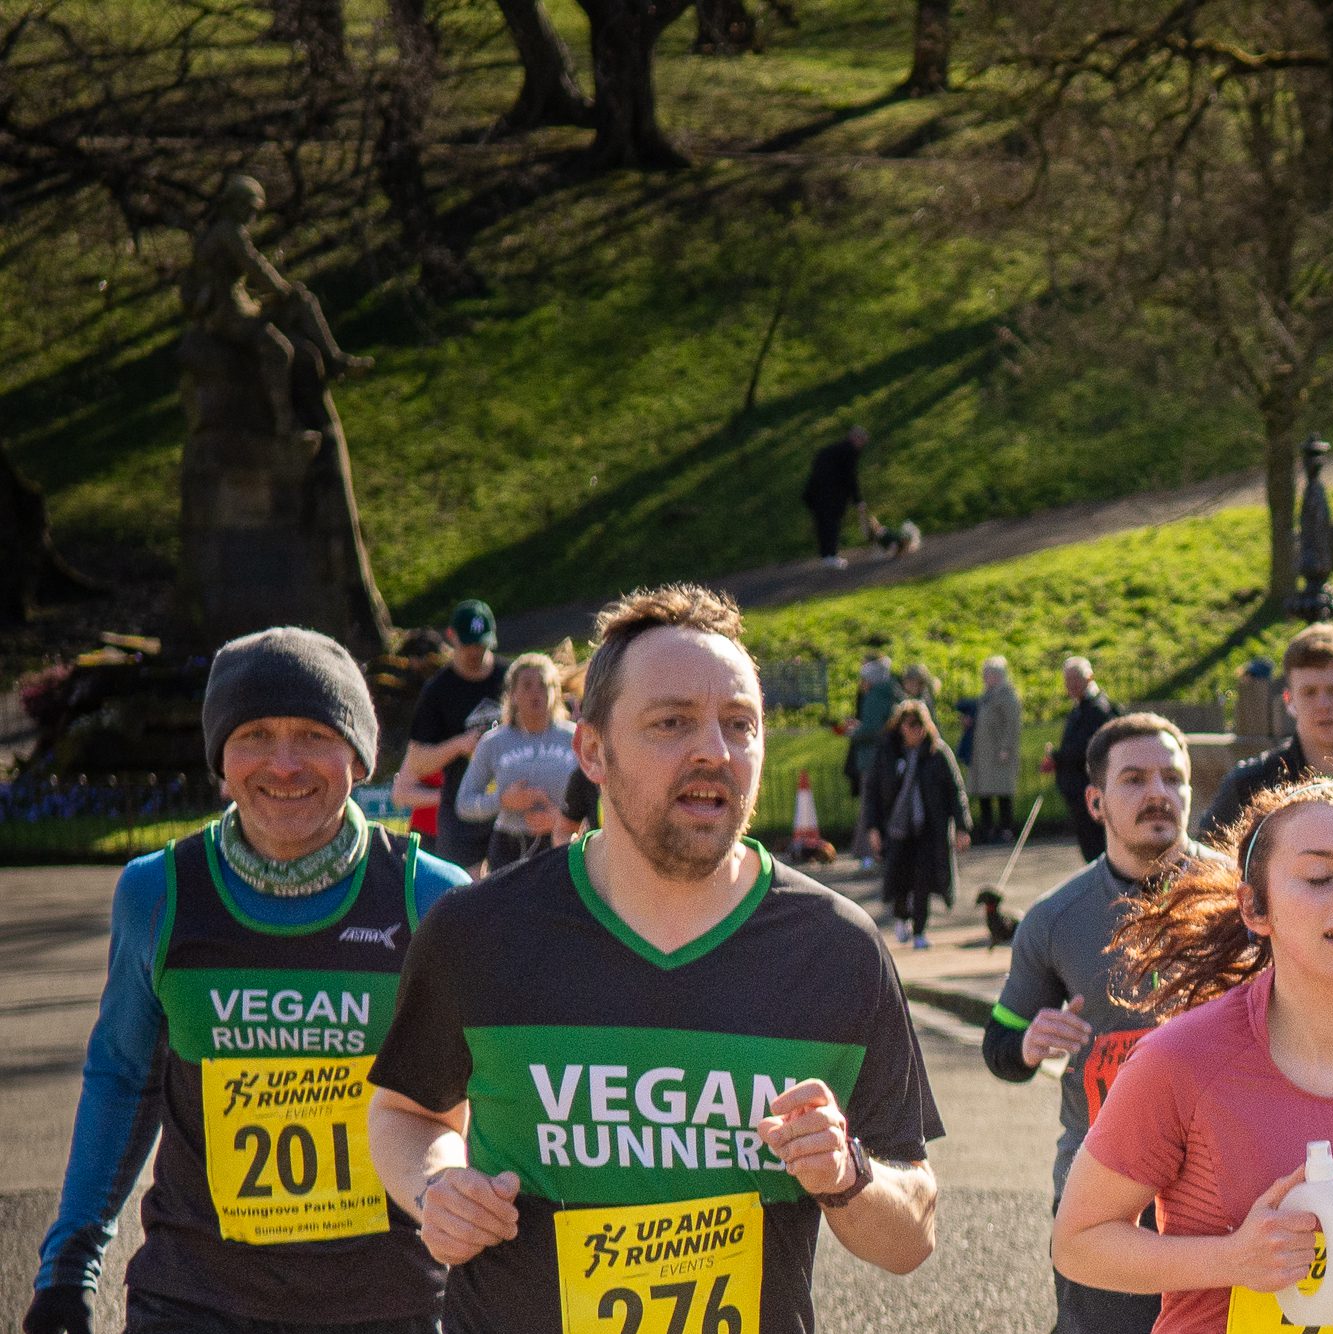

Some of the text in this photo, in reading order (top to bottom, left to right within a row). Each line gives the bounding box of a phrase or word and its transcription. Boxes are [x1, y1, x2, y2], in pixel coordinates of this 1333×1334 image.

[210, 988, 370, 1025] VEGAN
[212, 1027, 366, 1053] RUNNERS
[268, 1066, 351, 1088] UP AND
[257, 1081, 363, 1107] RUNNING
[286, 1106, 333, 1119] EVENTS
[234, 1123, 351, 1199] 201
[304, 1200, 336, 1213] Park
[637, 1206, 732, 1242] UP AND
[625, 1224, 745, 1267] RUNNING
[660, 1256, 714, 1278] EVENTS
